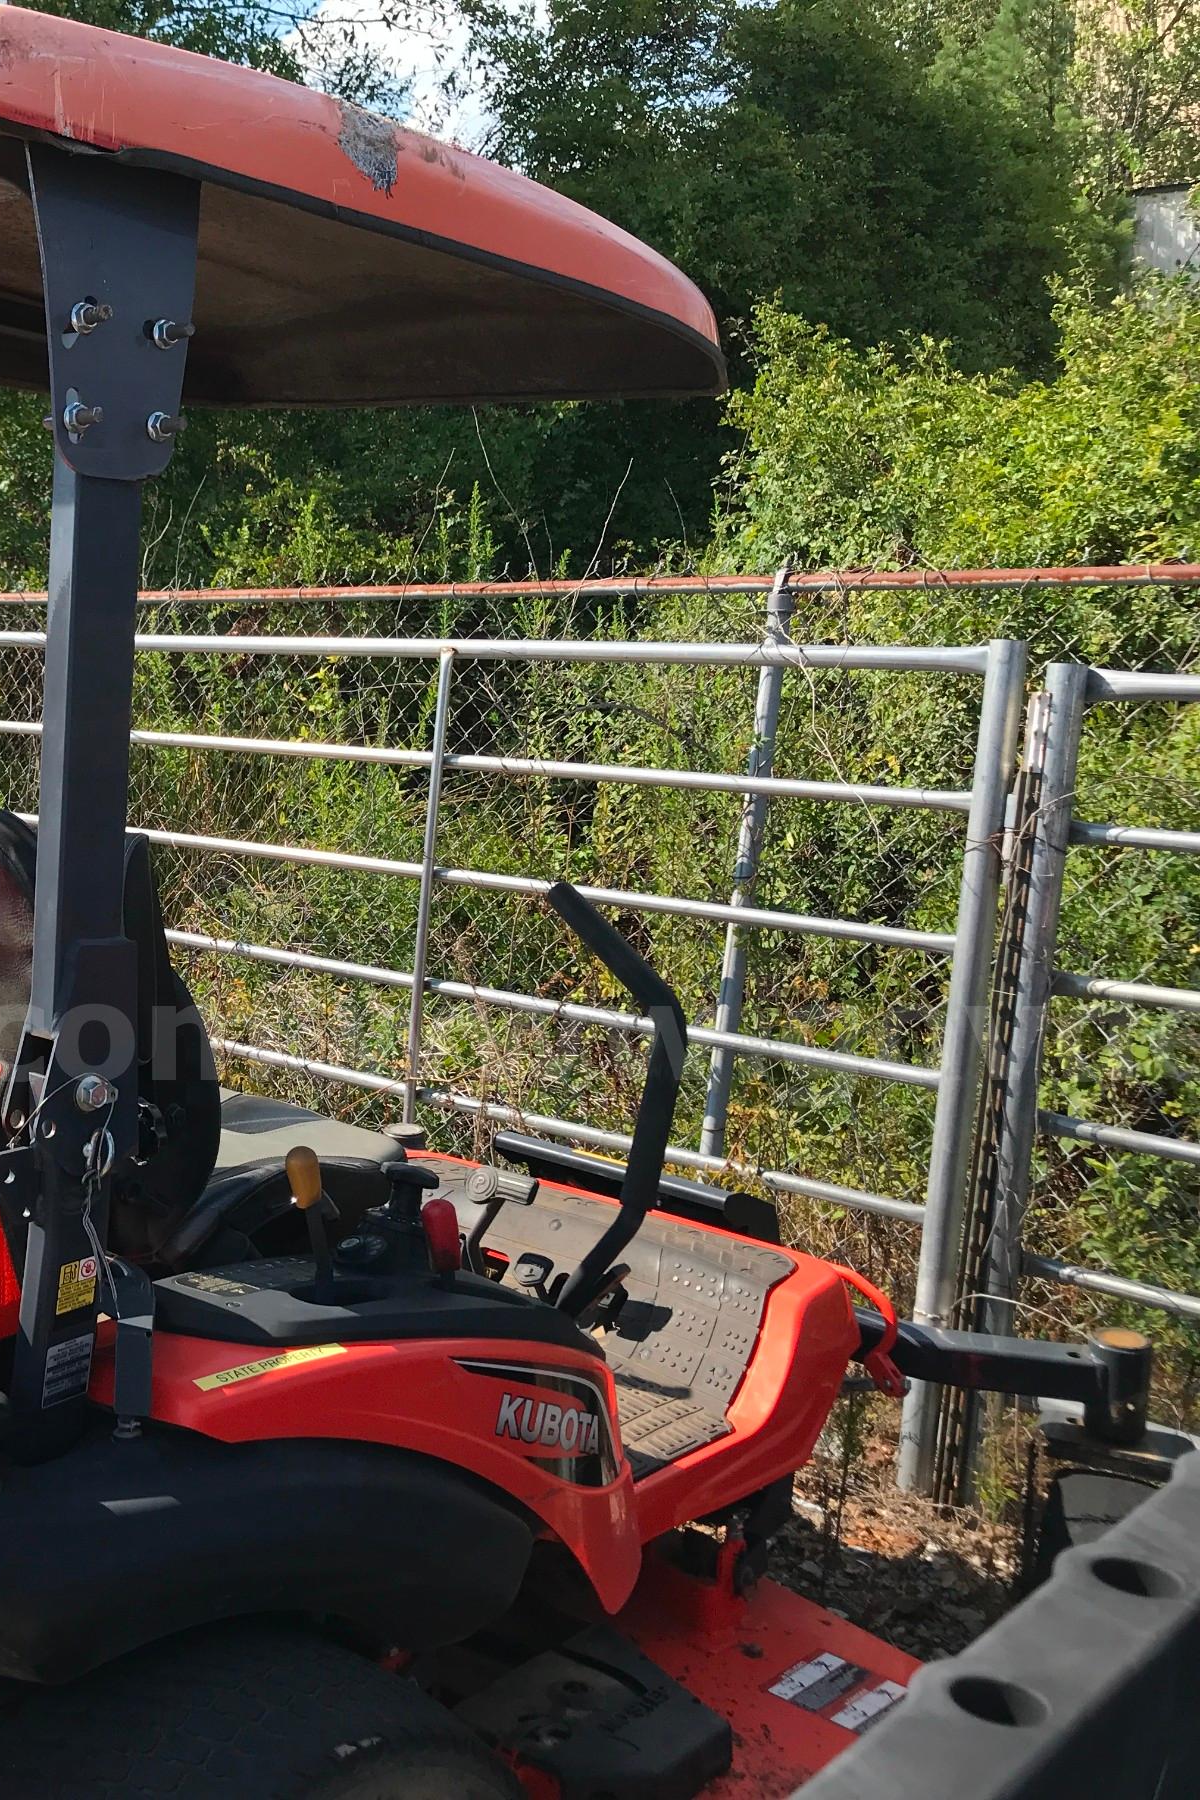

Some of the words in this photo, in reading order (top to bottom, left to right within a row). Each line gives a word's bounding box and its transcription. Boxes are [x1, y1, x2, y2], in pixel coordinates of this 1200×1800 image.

[216, 1364, 258, 1383] STATE
[259, 1347, 324, 1371] PROPERTY
[495, 1392, 600, 1455] KUBOTA
